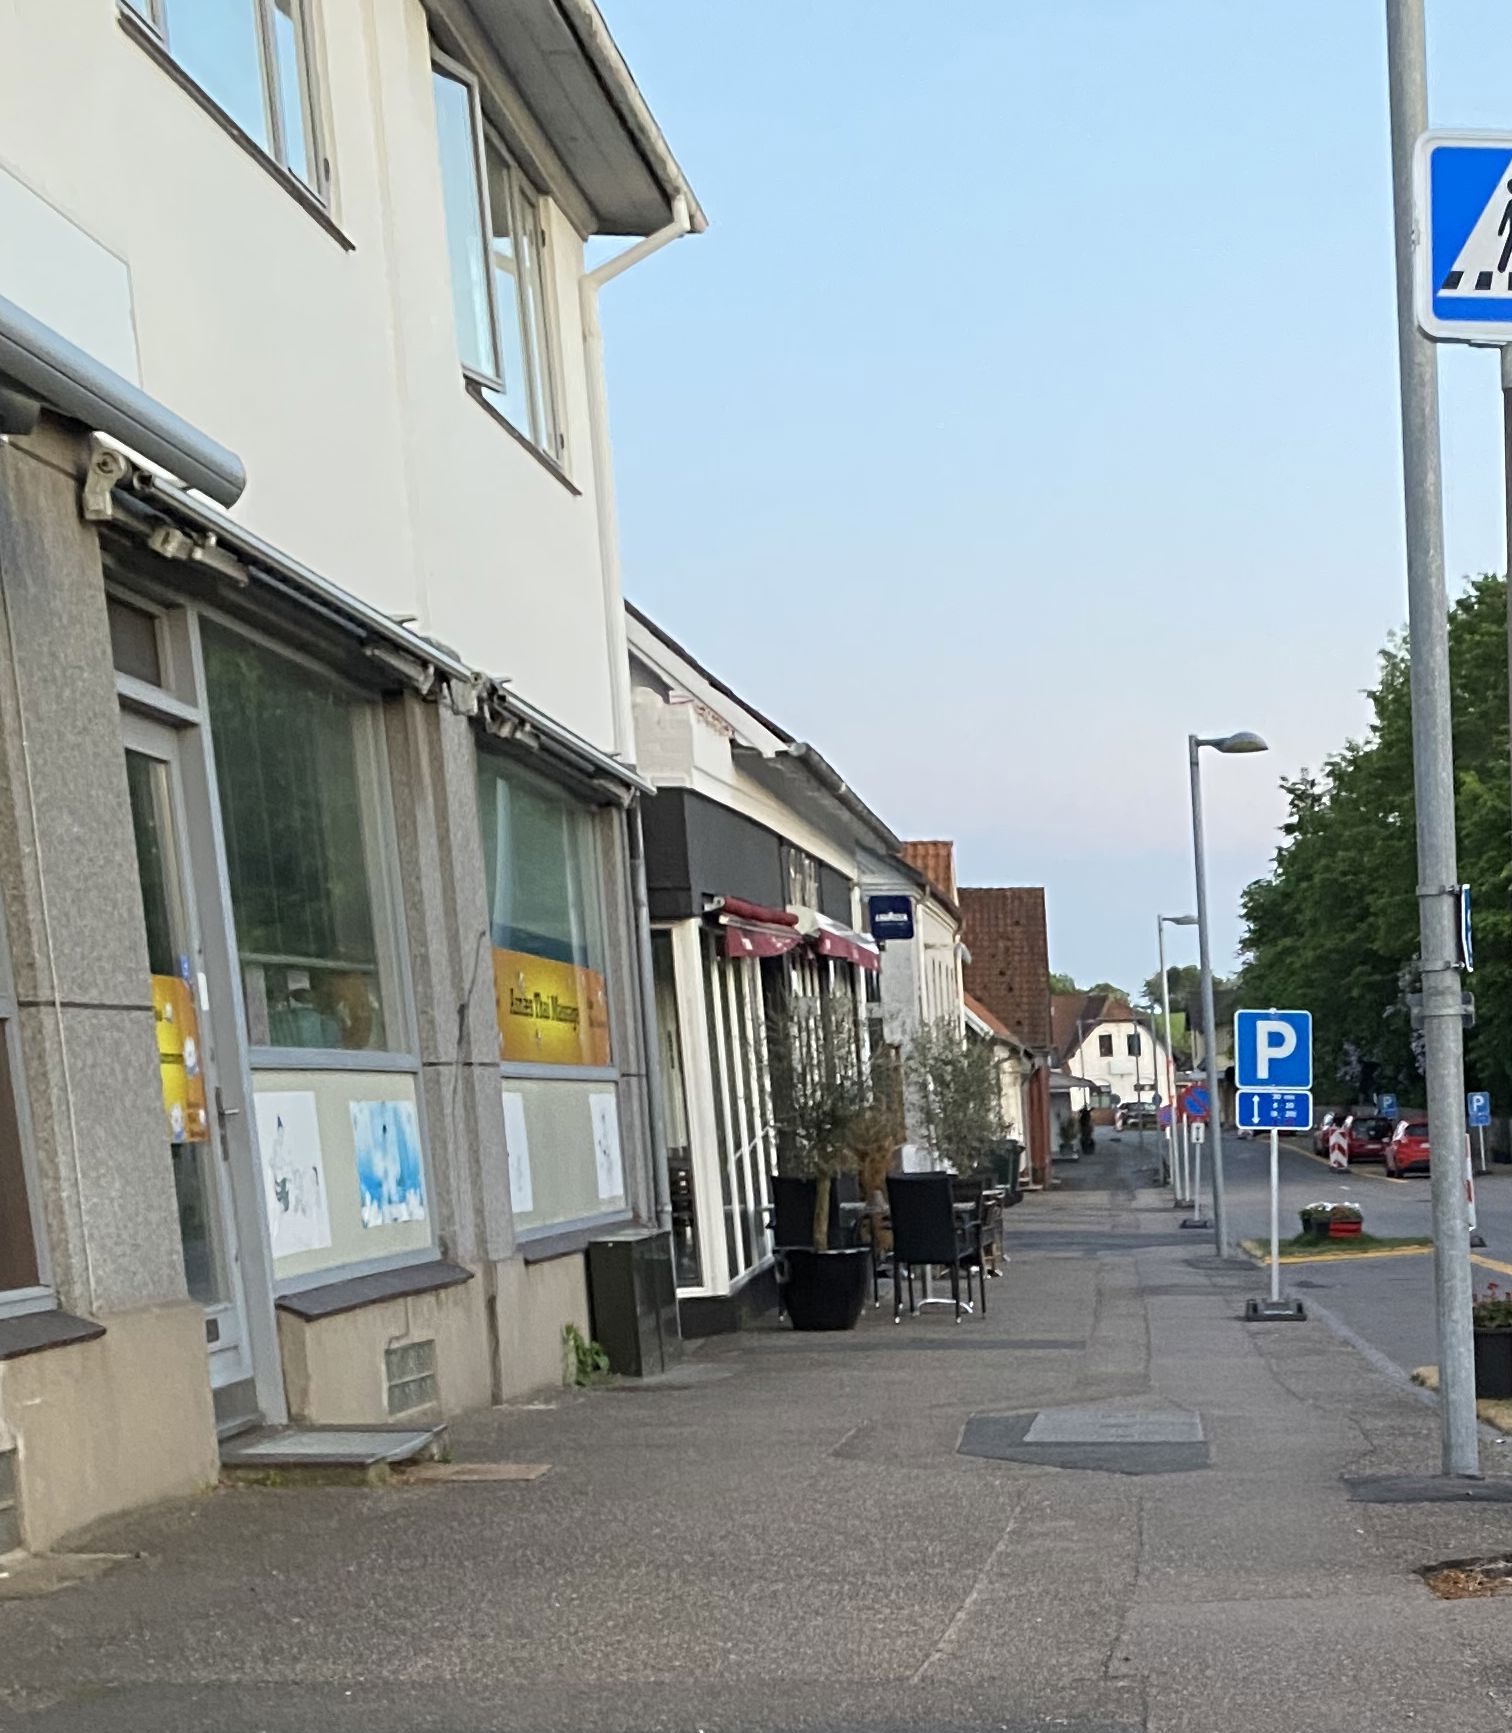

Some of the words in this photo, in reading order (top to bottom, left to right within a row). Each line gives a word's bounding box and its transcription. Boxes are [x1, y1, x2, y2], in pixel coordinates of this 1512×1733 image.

[1256, 1020, 1297, 1079] P
[1383, 1096, 1392, 1108] P
[1472, 1095, 1484, 1112] P
